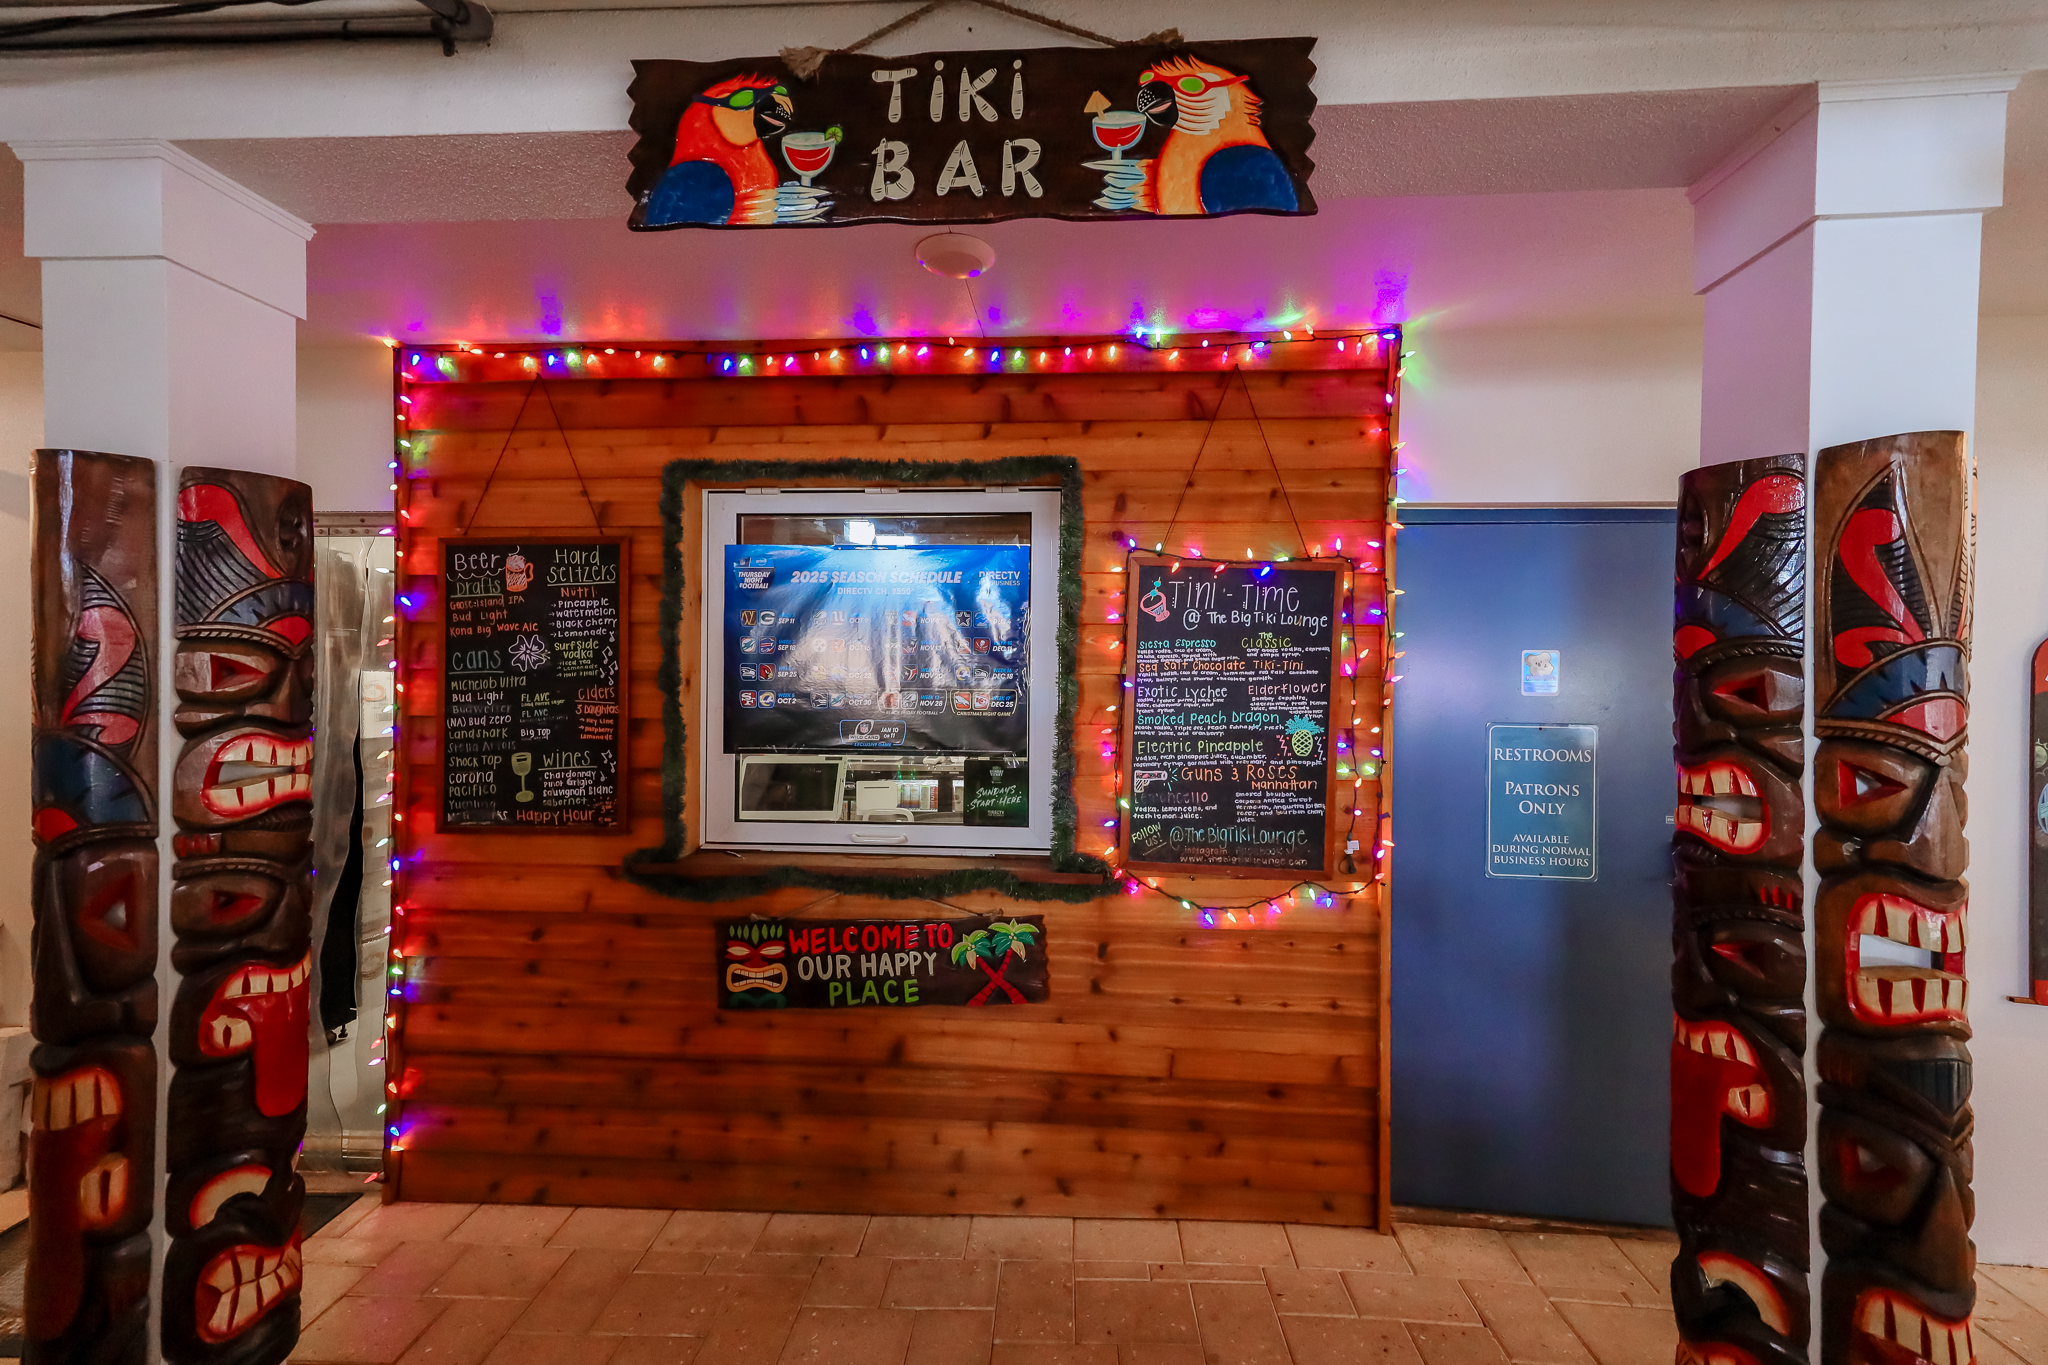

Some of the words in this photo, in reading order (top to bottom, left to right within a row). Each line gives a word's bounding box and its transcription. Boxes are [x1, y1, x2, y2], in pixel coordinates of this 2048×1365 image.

[870, 137, 1044, 202] BAR
[454, 552, 501, 571] Beer
[555, 545, 600, 565] Hard
[791, 570, 828, 583] 2025
[830, 570, 888, 584] SEASON
[890, 571, 963, 584] SCHEDULE
[979, 570, 1021, 580] DIRECTV
[456, 577, 501, 595] Drafts
[837, 587, 873, 595] DIRECTV
[508, 595, 525, 605] IPA
[558, 597, 609, 608] Pineapple
[1242, 580, 1300, 612] Time
[452, 611, 472, 622] Bud
[480, 609, 508, 625] Light
[556, 618, 583, 628] Black
[1206, 611, 1228, 624] The
[1231, 610, 1251, 627] Big
[1280, 614, 1328, 636] Lounge
[450, 625, 473, 638] Kona
[477, 625, 492, 638] Big
[558, 627, 607, 637] Lemonade
[1258, 632, 1273, 640] The
[1175, 638, 1216, 649] Espresso
[1241, 636, 1291, 649] Classic
[1140, 663, 1158, 673] Sea
[1163, 661, 1188, 671] Salt
[1193, 660, 1246, 671] Chocolate
[1138, 685, 1178, 698] Exotic
[1185, 685, 1228, 704] Lychee
[1248, 682, 1326, 695] Elderflower
[452, 692, 472, 702] Bud
[478, 691, 504, 705] Light
[575, 704, 583, 714] 3
[446, 716, 466, 729] (NA)
[469, 715, 486, 726] Bud
[1138, 712, 1184, 726] Smoked
[1190, 710, 1226, 725] Peach
[1232, 711, 1280, 728] Dragon
[1138, 738, 1192, 754] Electric
[1198, 739, 1263, 755] Pineapple
[1494, 748, 1592, 763] RESTROOMS
[1181, 767, 1223, 783] Guns
[1246, 764, 1298, 781] Roses
[976, 785, 1016, 798] SUNDAYS
[1252, 780, 1318, 791] Manhattan
[1504, 781, 1580, 797] PATRONS
[970, 799, 996, 810] START
[999, 796, 1022, 806] HERE
[1518, 800, 1566, 816] ONLY
[516, 809, 560, 825] Happy
[563, 808, 595, 822] Hour
[1512, 834, 1570, 844] AVAILABLE
[1492, 844, 1539, 855] DURING
[1542, 846, 1591, 856] NORMAL
[1494, 855, 1546, 866] BUSINESS
[1549, 857, 1589, 867] HOURS
[788, 924, 920, 955] WELCOME
[925, 922, 954, 949] TO
[797, 954, 852, 981] OUR
[860, 951, 937, 978] HAPPY
[829, 979, 920, 1007] PLACE
